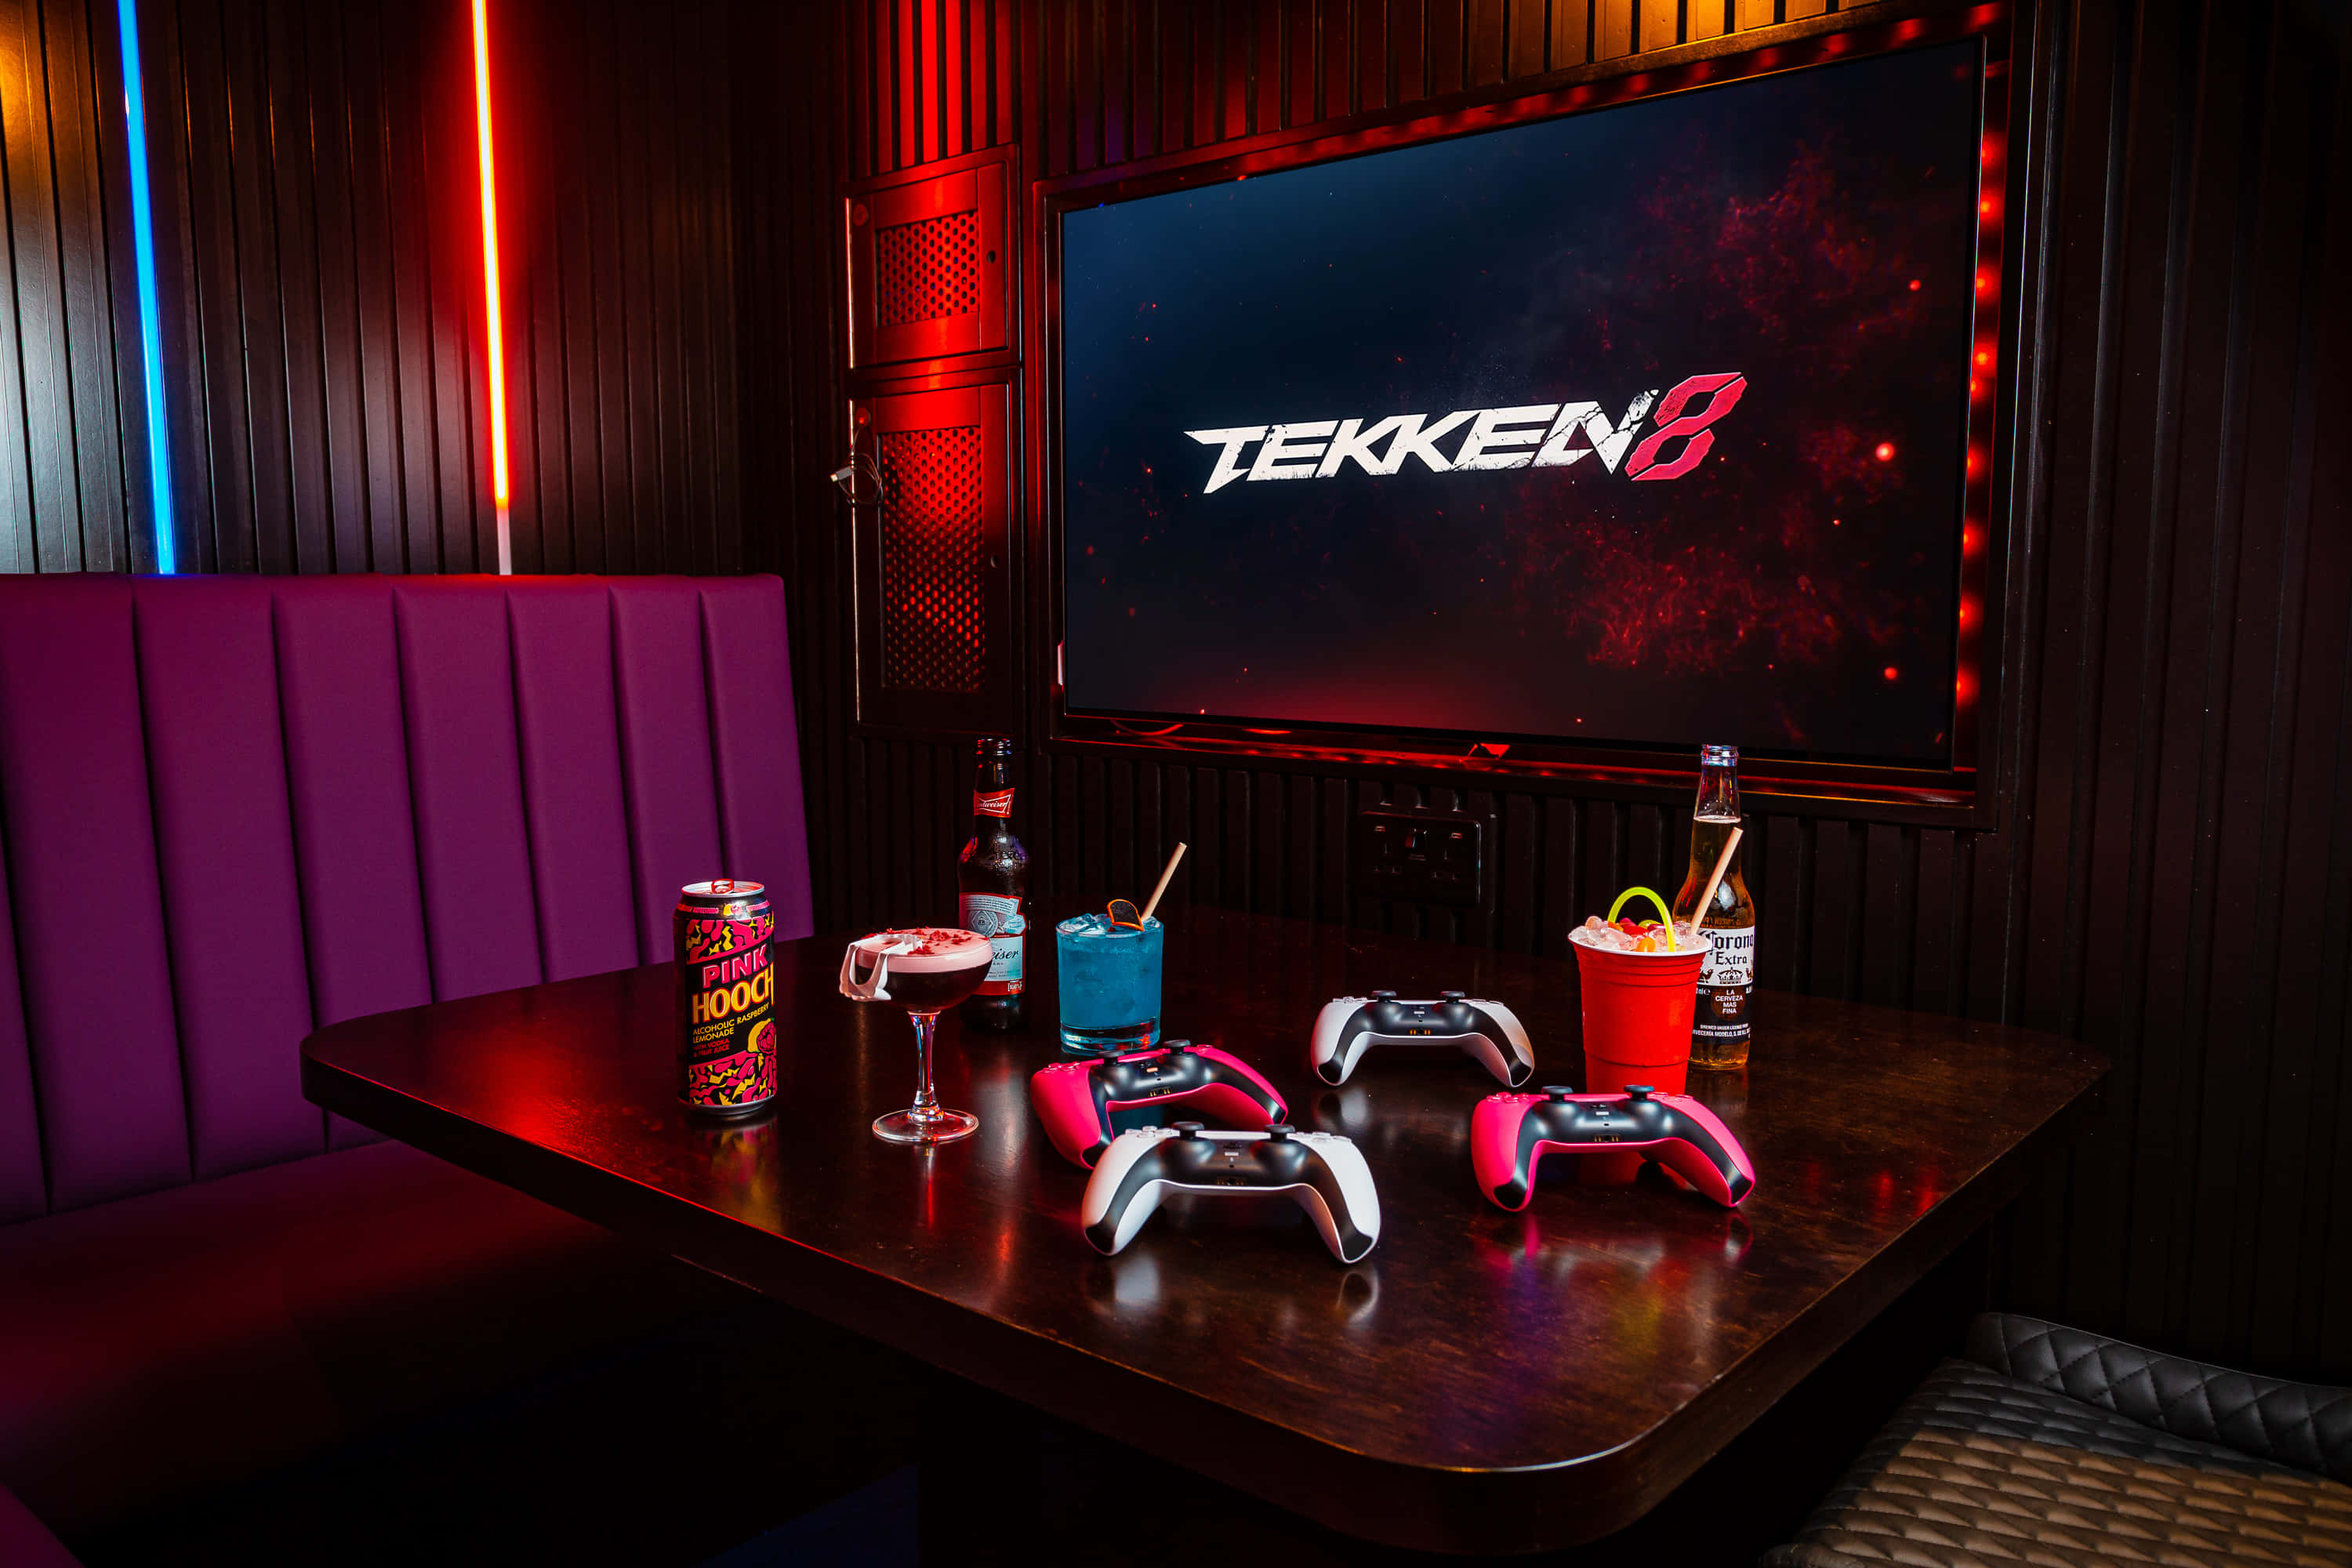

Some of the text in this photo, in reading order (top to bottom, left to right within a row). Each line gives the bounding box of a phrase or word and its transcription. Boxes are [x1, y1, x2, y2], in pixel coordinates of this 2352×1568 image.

[1183, 372, 1748, 494] TEKKEN 8
[992, 948, 1019, 960] eiser
[1715, 951, 1748, 965] Extra
[702, 943, 768, 989] PINK
[692, 961, 775, 1025] HOOCH
[693, 1001, 769, 1035] ALCOHOLIC RASPBERRY
[693, 1027, 735, 1044] LEMONADE
[707, 1038, 730, 1048] VODKA
[713, 1044, 730, 1054] JUICE
